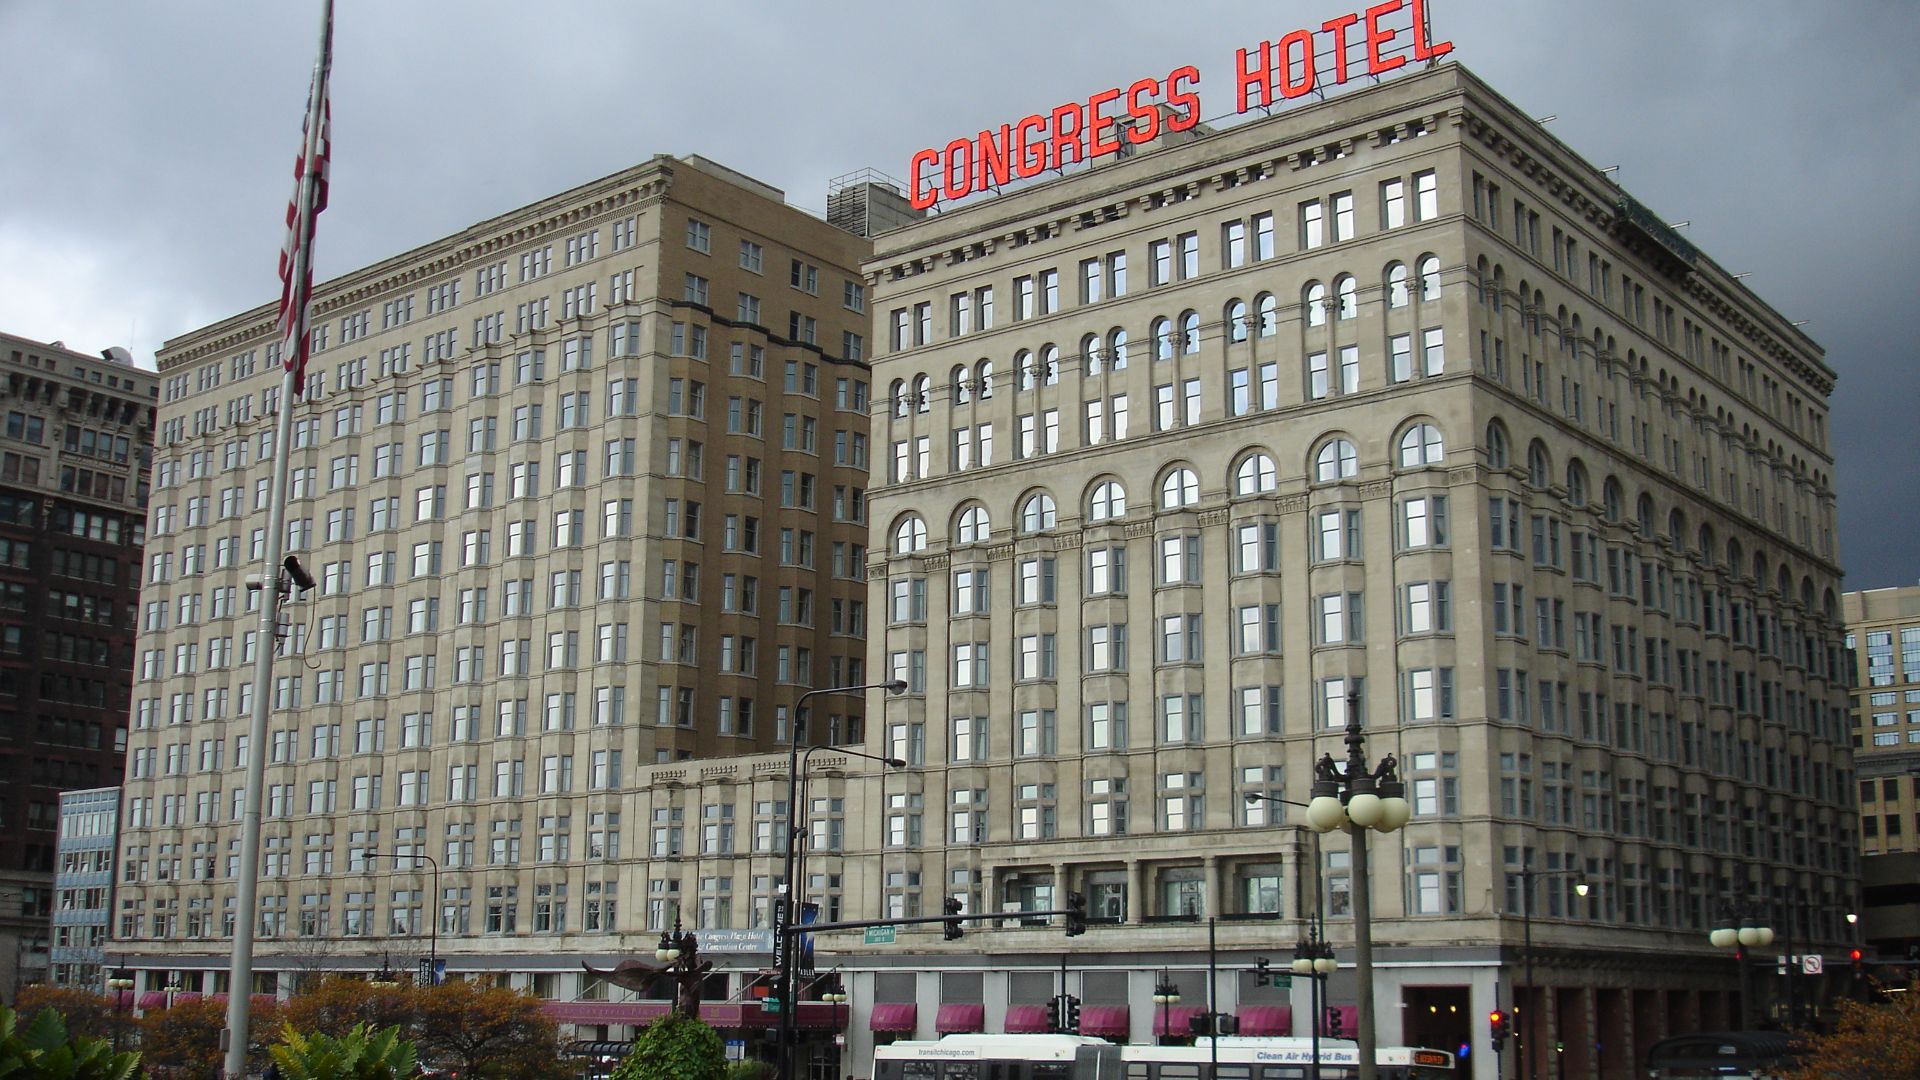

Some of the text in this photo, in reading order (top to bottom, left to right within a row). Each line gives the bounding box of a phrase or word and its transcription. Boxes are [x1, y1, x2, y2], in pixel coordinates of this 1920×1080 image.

[909, 0, 1454, 210] CONGRESS HOTEL
[704, 932, 729, 943] Congress
[748, 932, 764, 941] Hotel
[705, 943, 738, 951] Convention
[739, 943, 758, 951] Center
[918, 1048, 975, 1057] transitchicago.com
[1257, 1052, 1353, 1062] Clean Air Hyrid Bus
